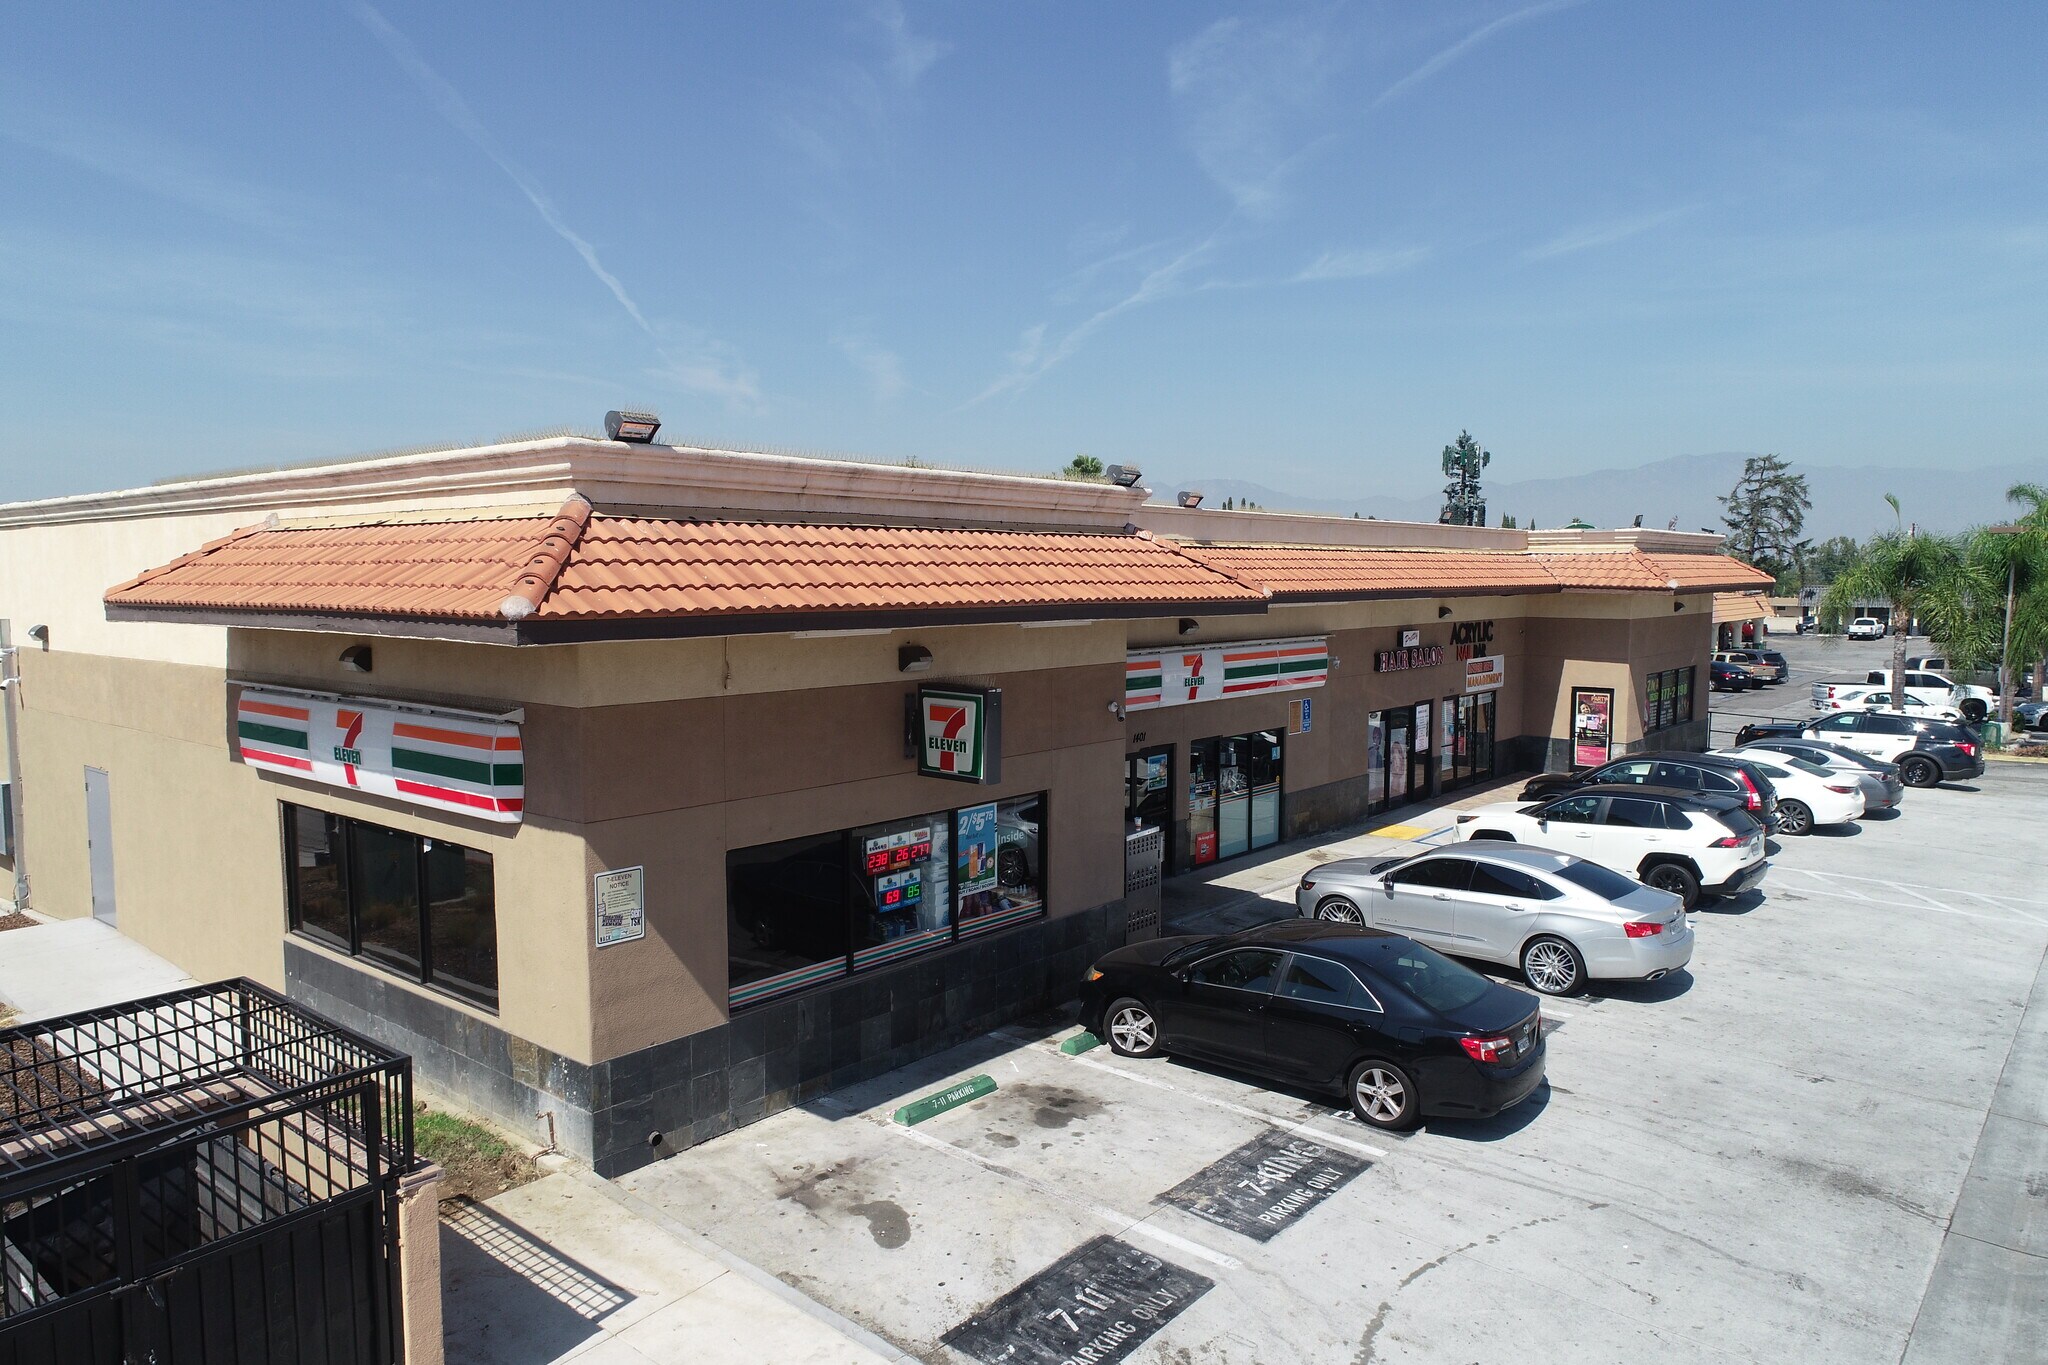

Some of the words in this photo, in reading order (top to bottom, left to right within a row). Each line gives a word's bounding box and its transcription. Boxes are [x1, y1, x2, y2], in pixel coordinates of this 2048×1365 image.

[1450, 621, 1493, 645] ACRYLIC
[1380, 650, 1409, 672] HAIR
[1411, 646, 1444, 670] SALON
[1183, 653, 1203, 700] 7
[335, 709, 363, 786] 7
[930, 704, 967, 773] 7
[868, 852, 888, 869] 238
[896, 847, 909, 861] 26
[911, 843, 930, 858] 277
[609, 881, 630, 890] NOTICE
[886, 889, 900, 904] 69
[907, 884, 920, 898] 85
[931, 1096, 947, 1110] 7-11
[947, 1085, 975, 1102] PARKING
[1258, 1188, 1314, 1225] PARKING
[1306, 1167, 1344, 1189] ONLY
[1131, 1287, 1178, 1320] ONLY
